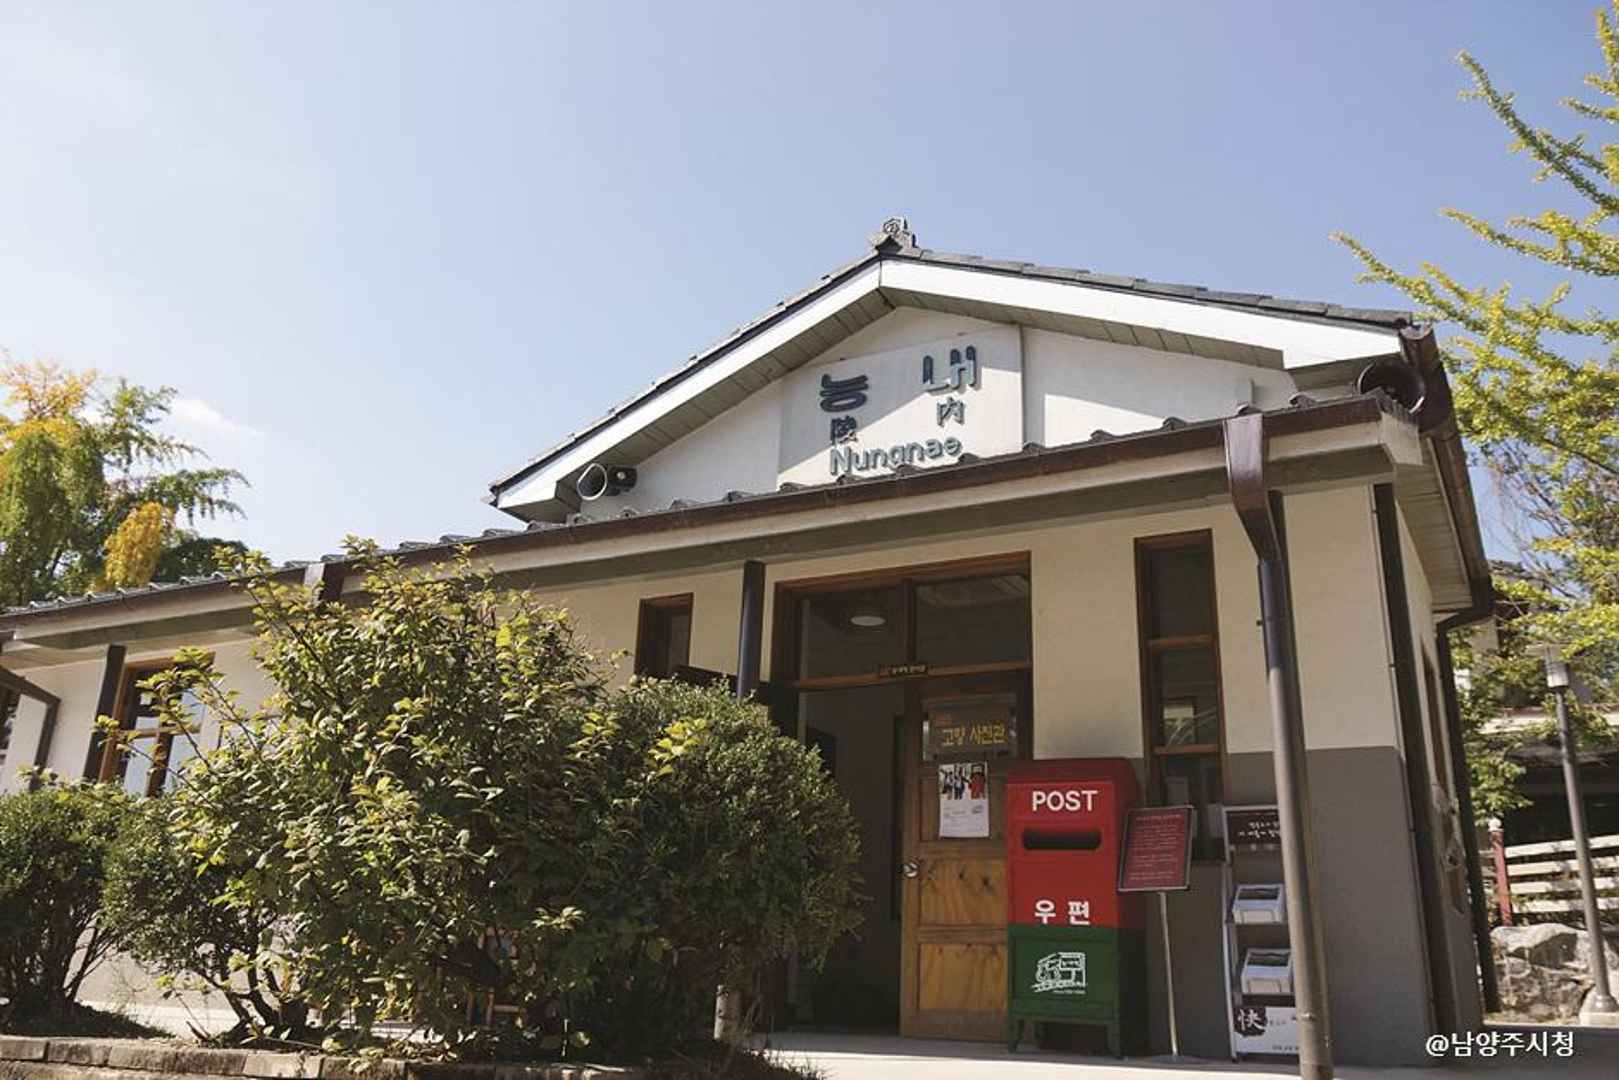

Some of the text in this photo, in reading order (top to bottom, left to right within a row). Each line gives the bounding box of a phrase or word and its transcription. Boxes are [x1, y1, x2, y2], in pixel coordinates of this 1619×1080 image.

[820, 346, 976, 412] 능 내
[830, 438, 962, 475] Nungnae
[1032, 790, 1098, 812] POST
[1035, 900, 1091, 925] 우 편
